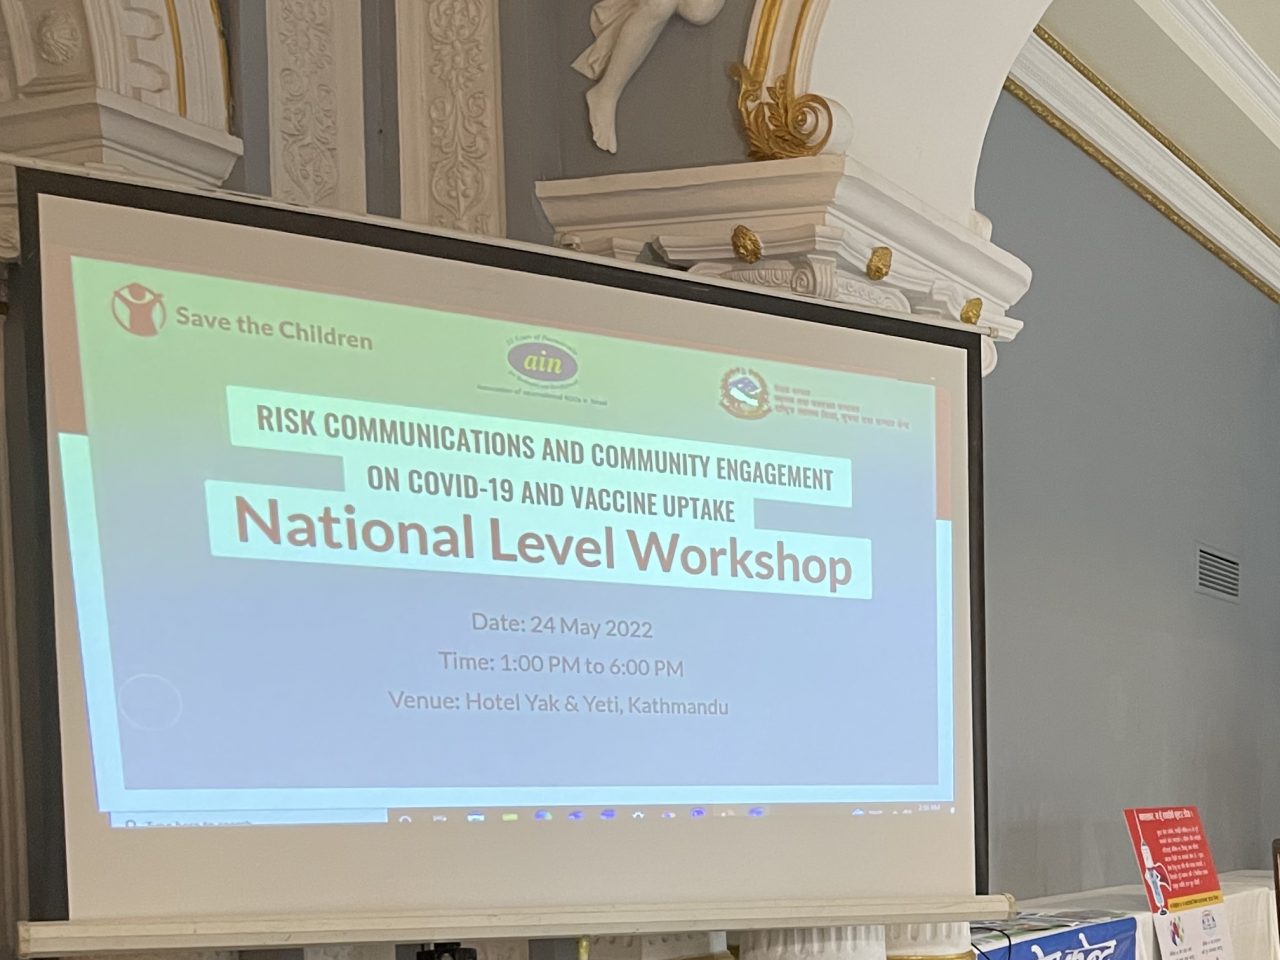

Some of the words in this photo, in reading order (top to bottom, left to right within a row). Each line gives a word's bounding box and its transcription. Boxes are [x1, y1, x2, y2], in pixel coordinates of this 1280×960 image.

[176, 307, 231, 331] Save
[237, 315, 274, 337] the
[279, 321, 373, 350] Children
[523, 350, 562, 374] ain
[257, 405, 317, 437] RISK
[324, 412, 535, 459] COMMUNICATIONS
[542, 437, 585, 465] AND
[591, 444, 710, 479] COMMUNITY
[716, 457, 834, 491] ENGAGEMENT
[367, 465, 400, 493] ON
[408, 469, 514, 502] COVID-19
[521, 481, 564, 508] AND
[570, 486, 657, 516] VACCINE
[663, 496, 735, 523] UPTAKE
[235, 496, 475, 560] National
[490, 518, 614, 569] Level
[626, 529, 852, 593] Workshop
[471, 612, 526, 633] Date:
[530, 617, 556, 634] 24
[560, 617, 601, 639] May
[605, 620, 653, 639] 2022
[438, 651, 495, 672] Time:
[500, 654, 544, 673] 1:00
[549, 656, 581, 674] PM
[585, 658, 605, 675] to
[609, 658, 650, 676] 6:00
[655, 660, 684, 677] PM
[388, 691, 461, 711] Venue:
[465, 692, 520, 711] Hotel
[525, 694, 560, 713] Yak
[565, 695, 580, 713] &
[583, 695, 624, 716] Yeti,
[628, 697, 729, 717] Kathmandu
